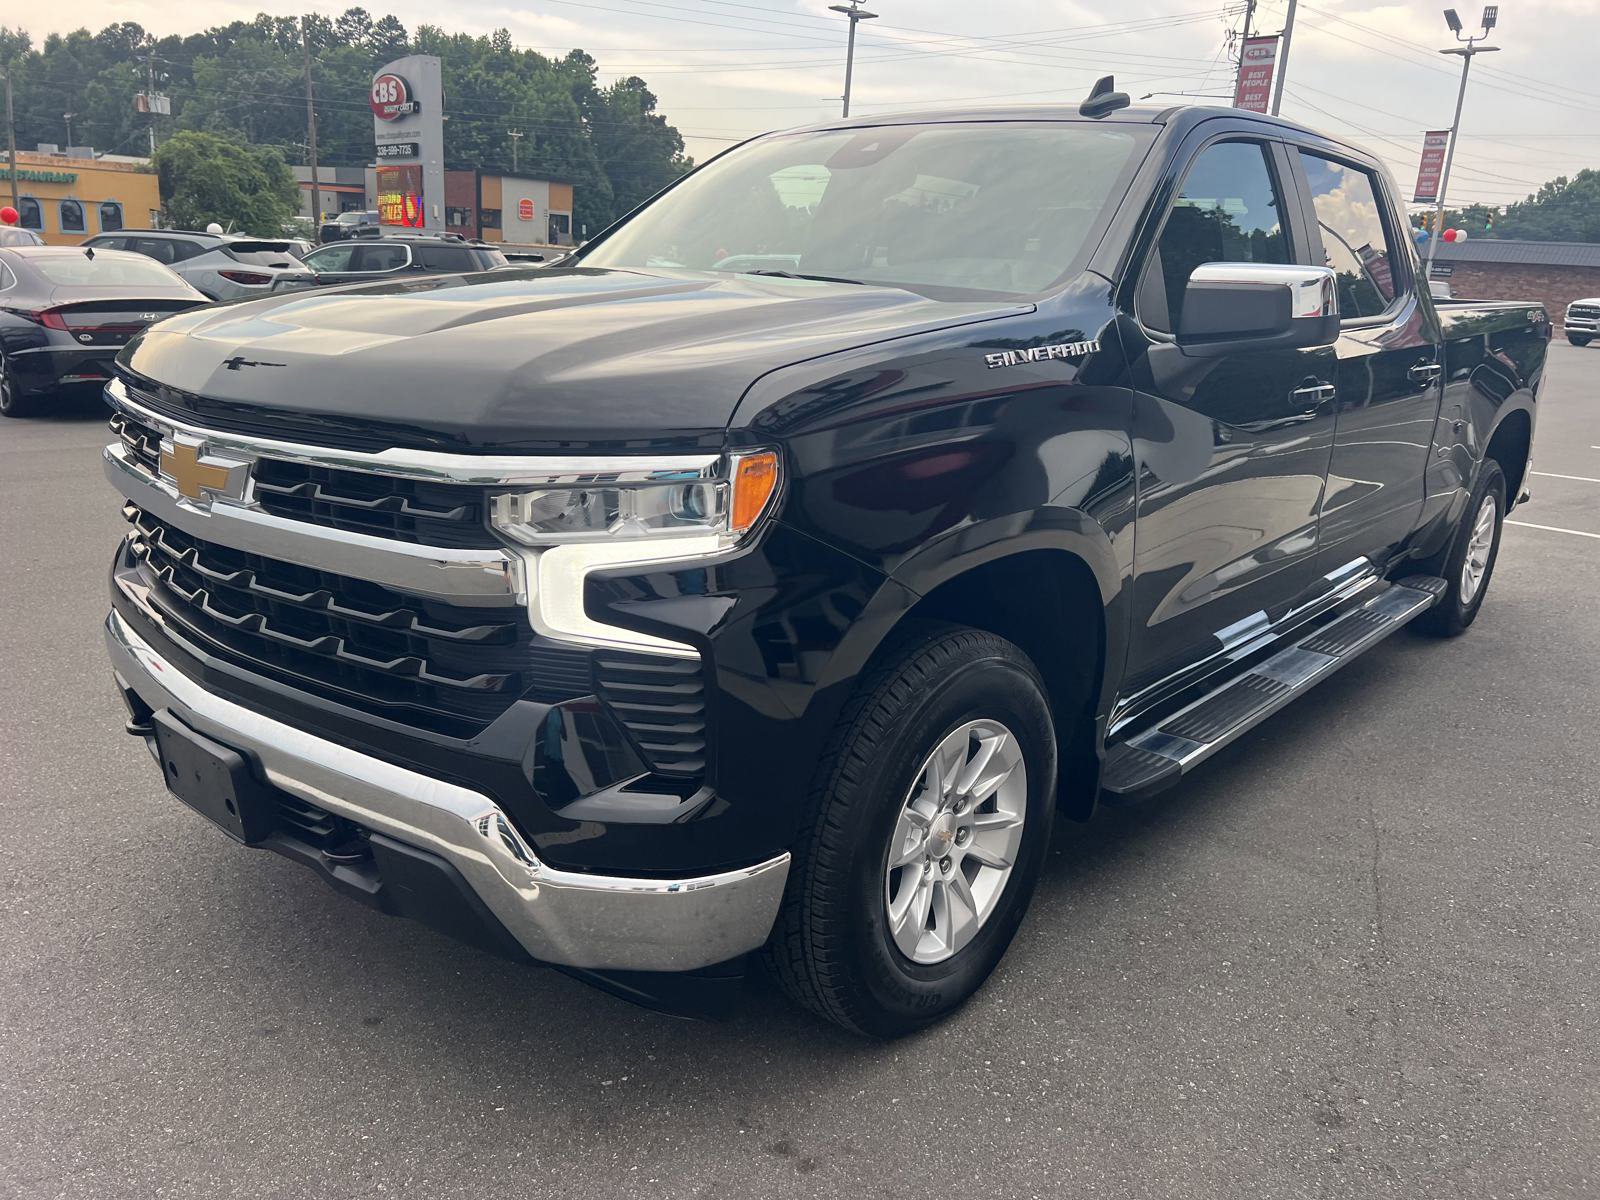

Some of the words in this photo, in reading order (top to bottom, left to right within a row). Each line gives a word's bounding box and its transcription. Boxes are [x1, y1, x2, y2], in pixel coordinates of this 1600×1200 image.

[1248, 71, 1266, 79] BEST
[1242, 79, 1269, 88] PEOPLE
[373, 80, 397, 104] CBS
[1244, 93, 1264, 101] BEST
[1237, 101, 1266, 109] SERVICE
[984, 340, 1100, 369] SILVERADO
